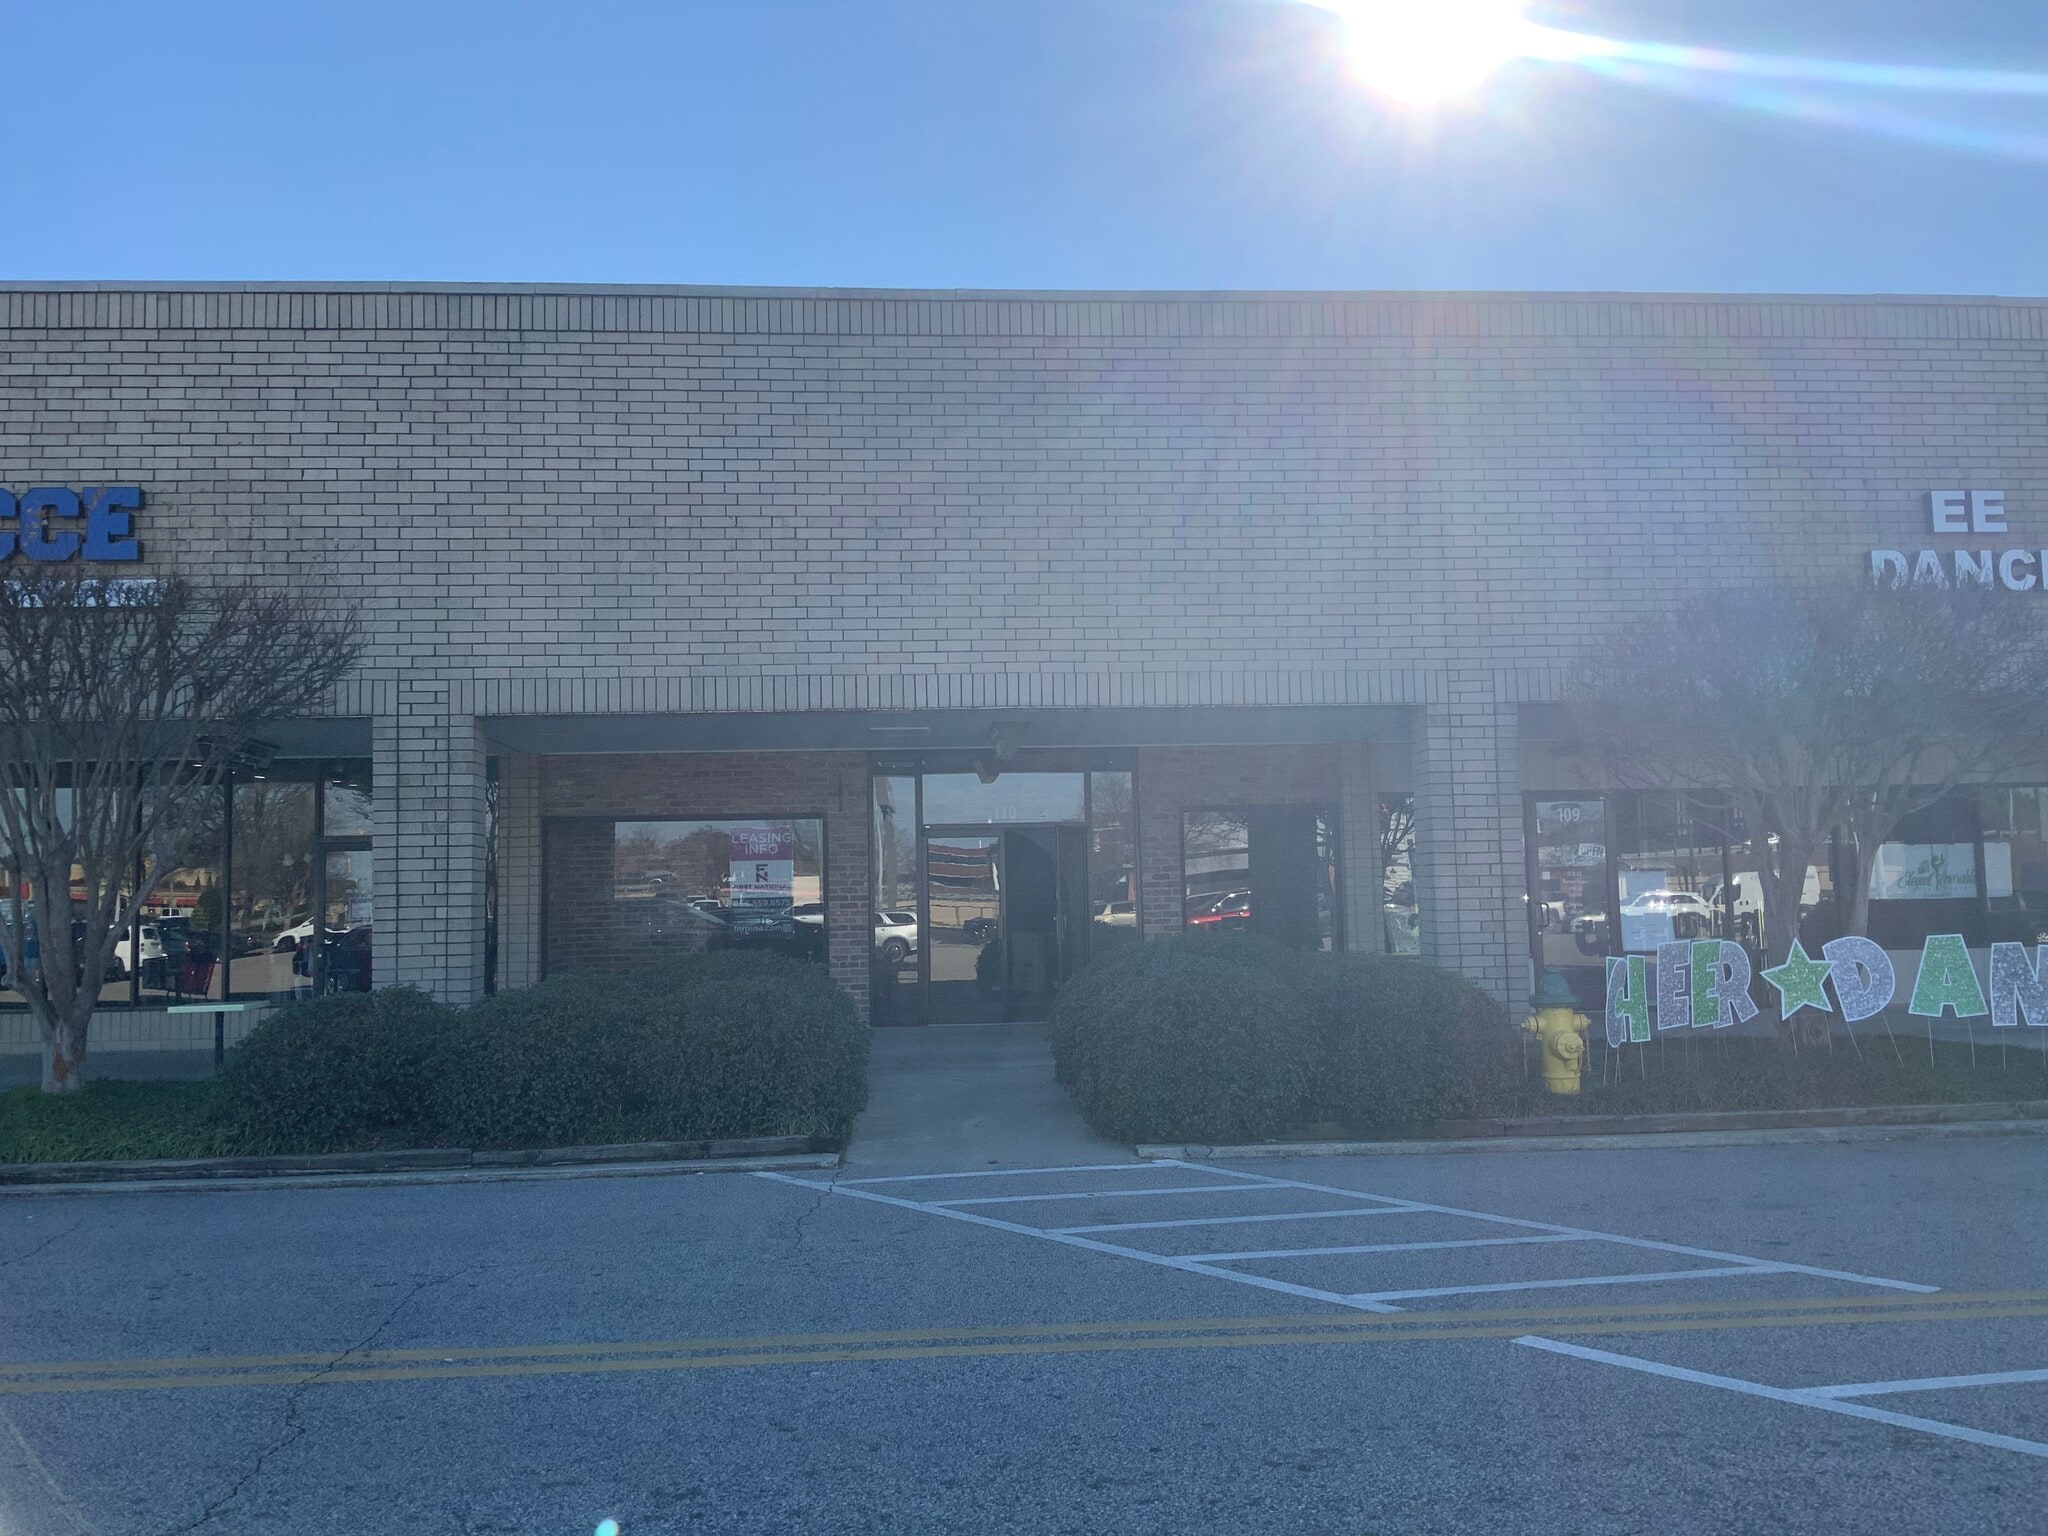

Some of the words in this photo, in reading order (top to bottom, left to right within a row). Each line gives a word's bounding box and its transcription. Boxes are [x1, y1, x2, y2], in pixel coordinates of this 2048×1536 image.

[0, 487, 142, 561] CE
[1931, 490, 2008, 533] EE
[1871, 549, 2048, 591] DANC
[1557, 807, 1580, 822] 109
[731, 832, 791, 844] LEASING
[745, 844, 778, 855] INFO
